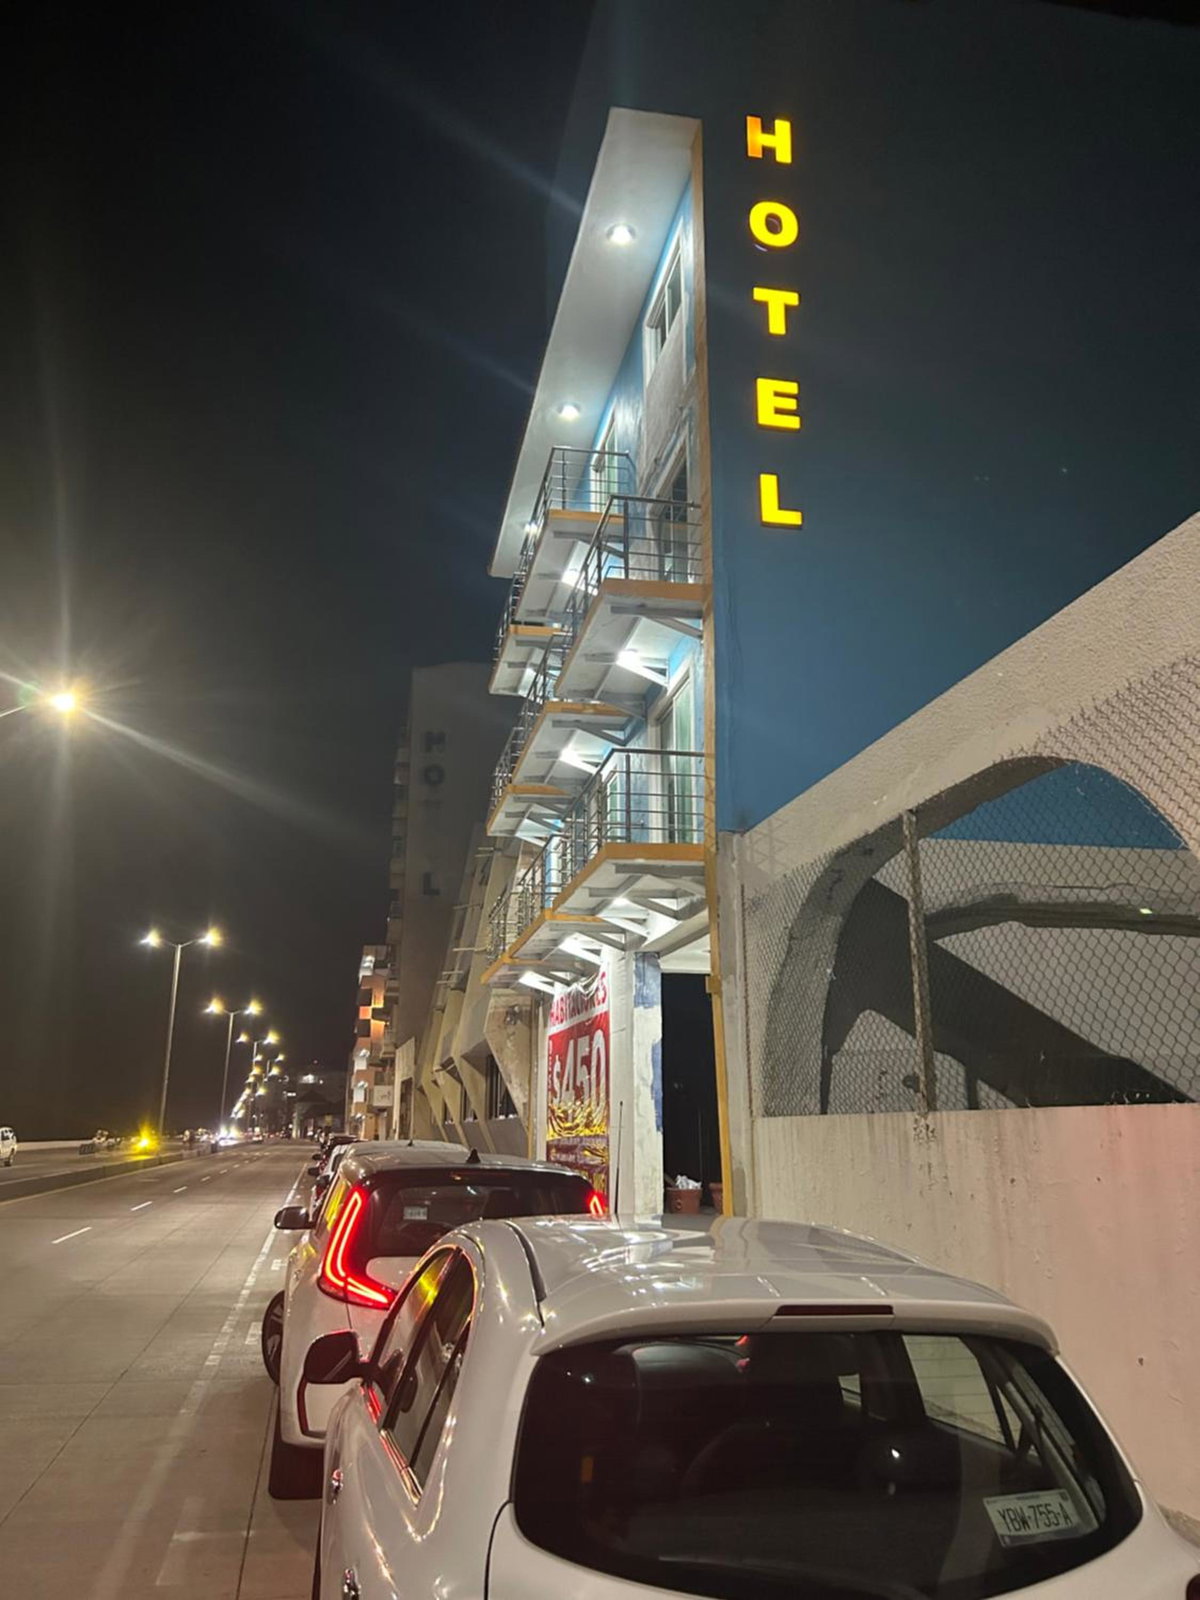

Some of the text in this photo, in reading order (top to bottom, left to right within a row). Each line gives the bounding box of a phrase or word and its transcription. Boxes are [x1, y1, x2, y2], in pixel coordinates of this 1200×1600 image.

[746, 115, 804, 528] HOTEL
[420, 730, 447, 897] HOL
[552, 1028, 607, 1127] $450
